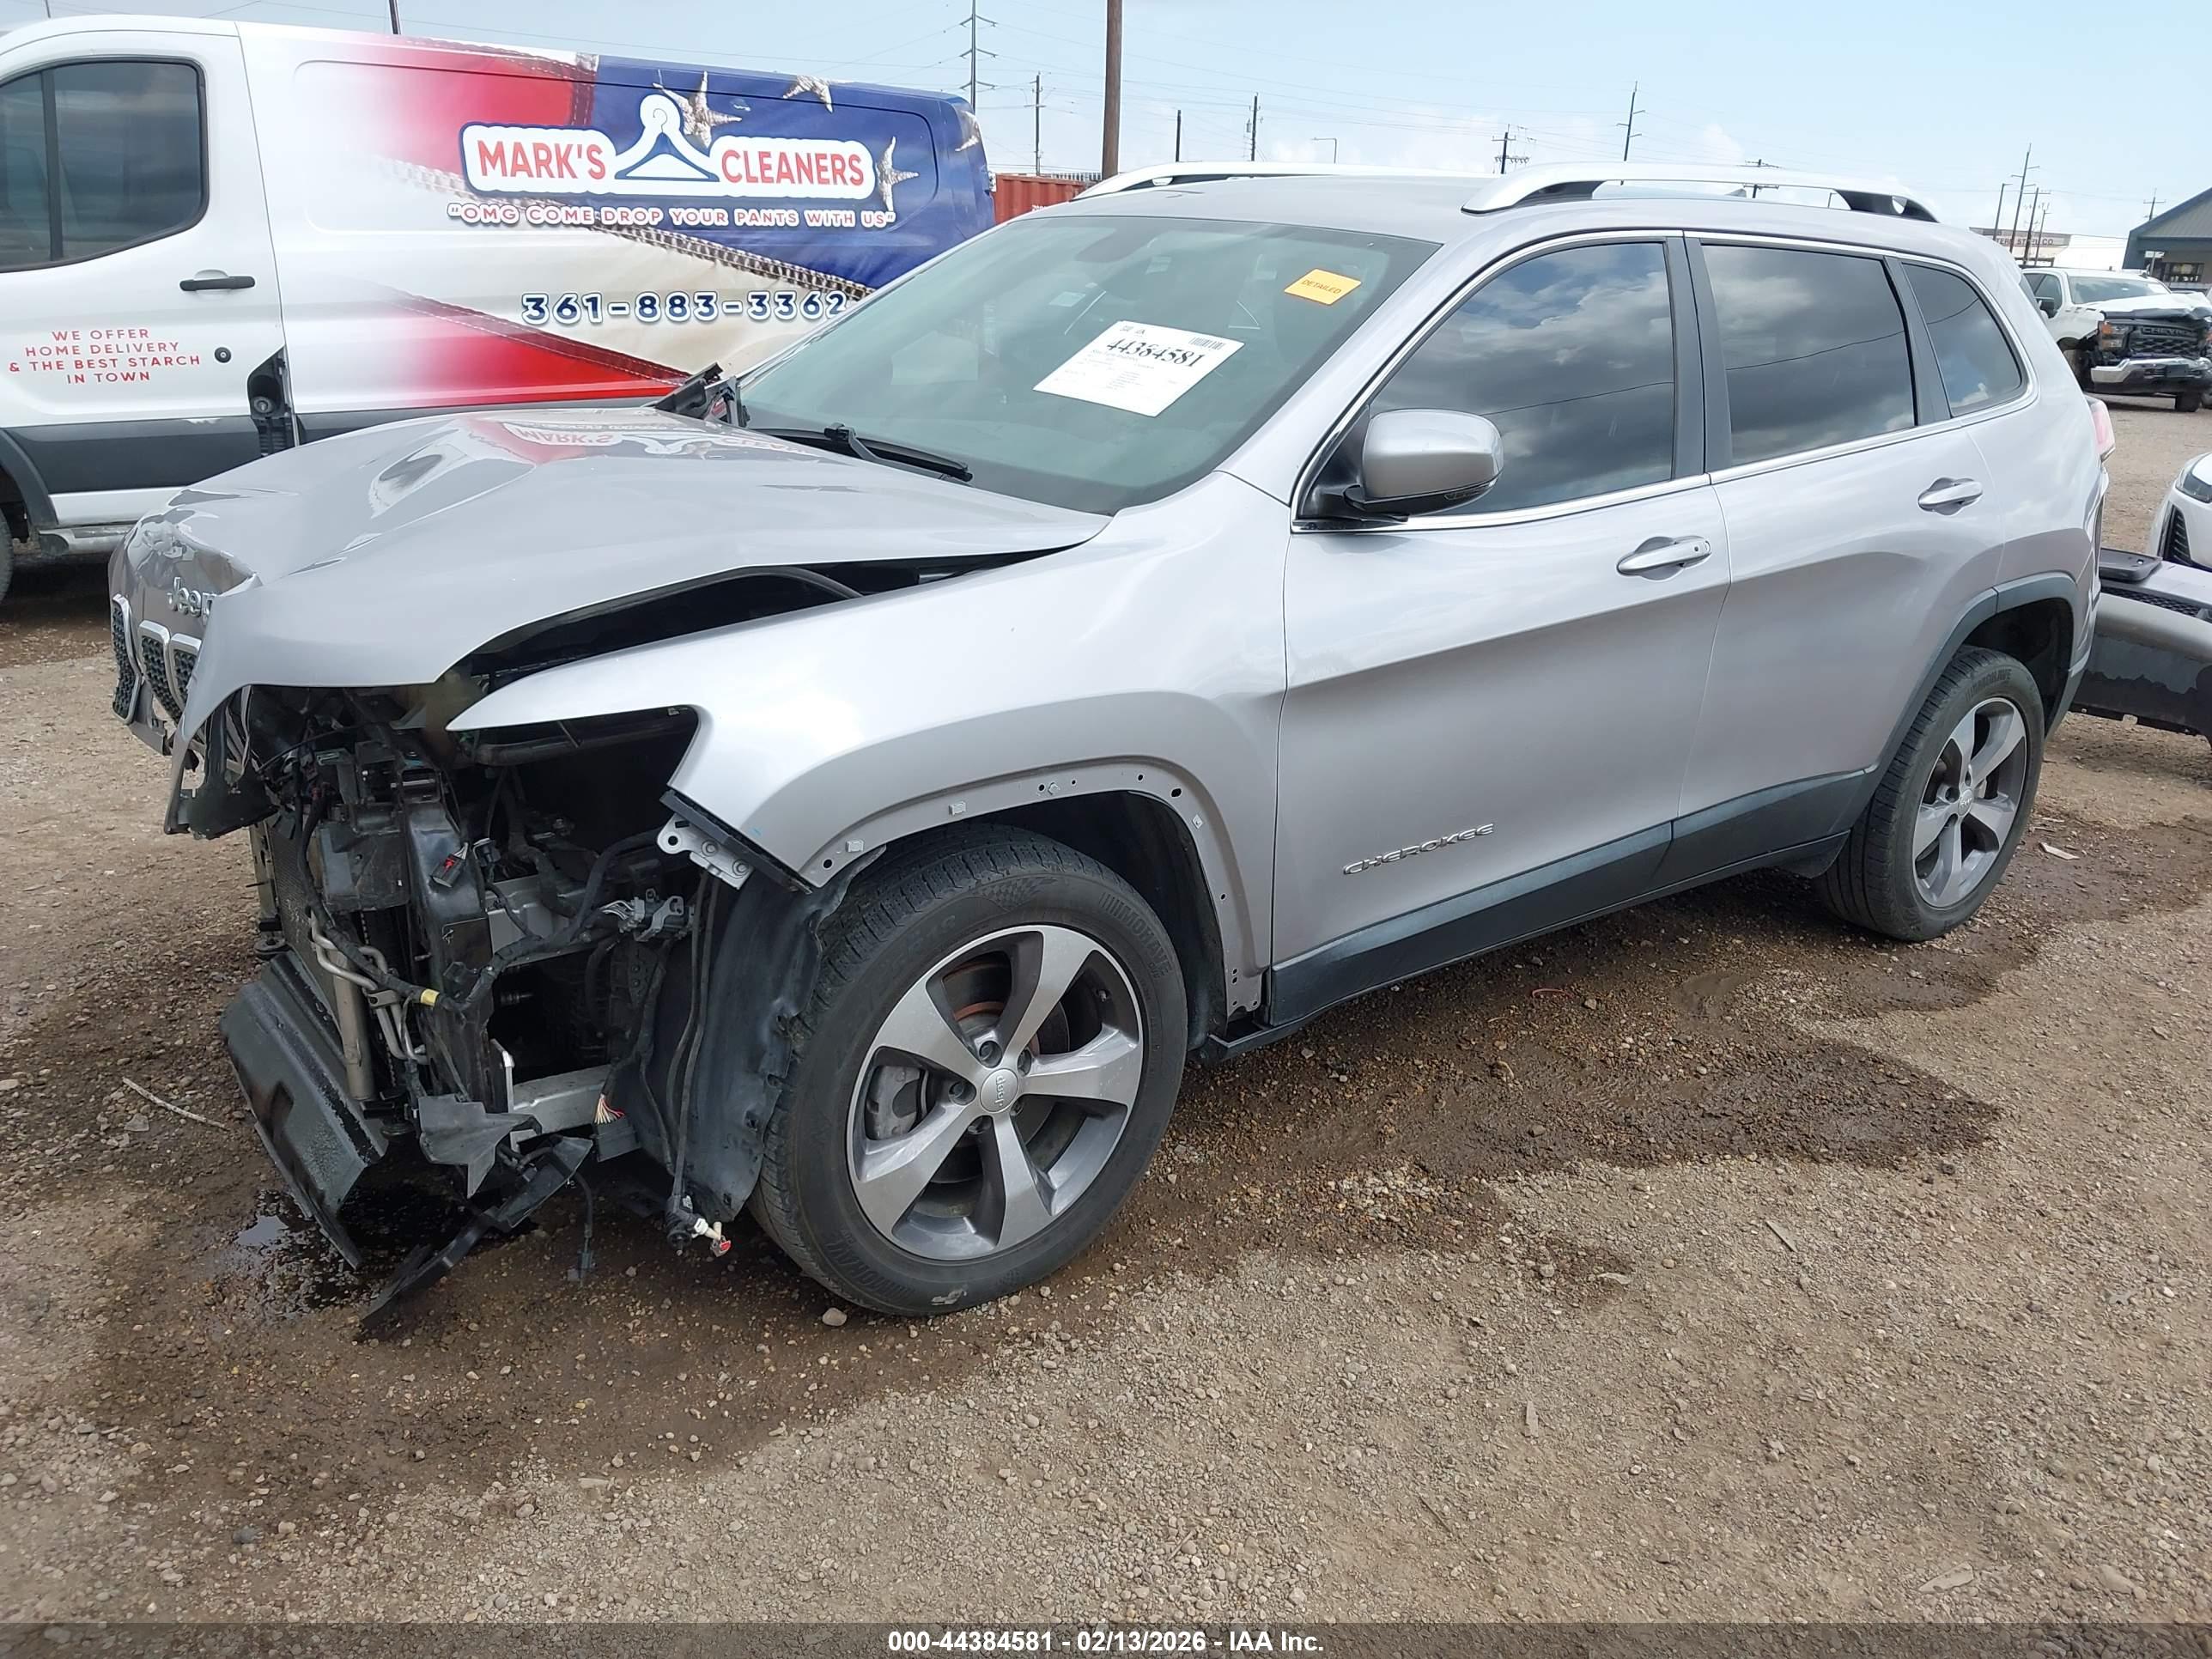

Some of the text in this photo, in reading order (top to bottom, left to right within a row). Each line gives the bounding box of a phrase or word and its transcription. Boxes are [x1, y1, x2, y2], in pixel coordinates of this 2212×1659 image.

[477, 139, 865, 186] MARK'S CLEANERS
[527, 206, 594, 224] COME
[603, 208, 662, 224] DROP
[671, 209, 728, 225] YOUR
[735, 210, 799, 226] PANTS
[805, 211, 854, 227] WITH
[1301, 278, 1341, 295] DETAILED
[520, 290, 847, 323] 361-883-3362
[52, 329, 149, 341] WE OFFER
[26, 342, 179, 356] HOME DELIVERY
[1107, 338, 1205, 368] 44384581
[9, 356, 200, 372] & THE BEST STARCH
[67, 371, 150, 384] IN TOWN
[1343, 822, 1495, 875] CHEROKEE
